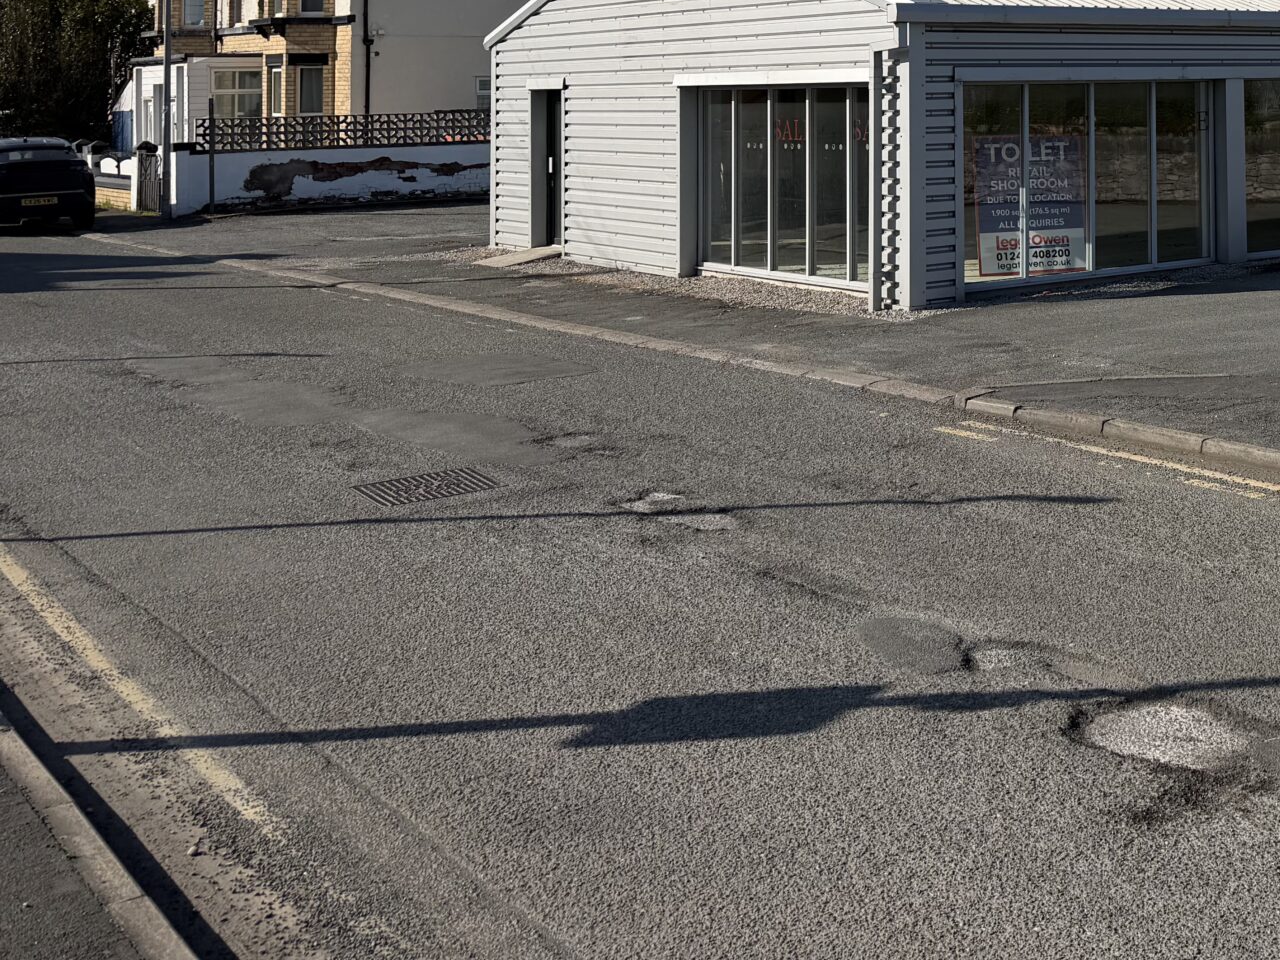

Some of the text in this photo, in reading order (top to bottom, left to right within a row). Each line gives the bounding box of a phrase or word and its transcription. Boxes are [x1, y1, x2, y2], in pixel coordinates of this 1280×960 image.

[984, 142, 1069, 163] TO LET
[1009, 167, 1050, 177] RAIL
[990, 178, 1068, 190] SHOROOM
[987, 196, 1004, 204] DUE
[1029, 193, 1073, 201] LOCATION
[999, 221, 1015, 229] ALL
[996, 248, 1071, 261] 0124 408200
